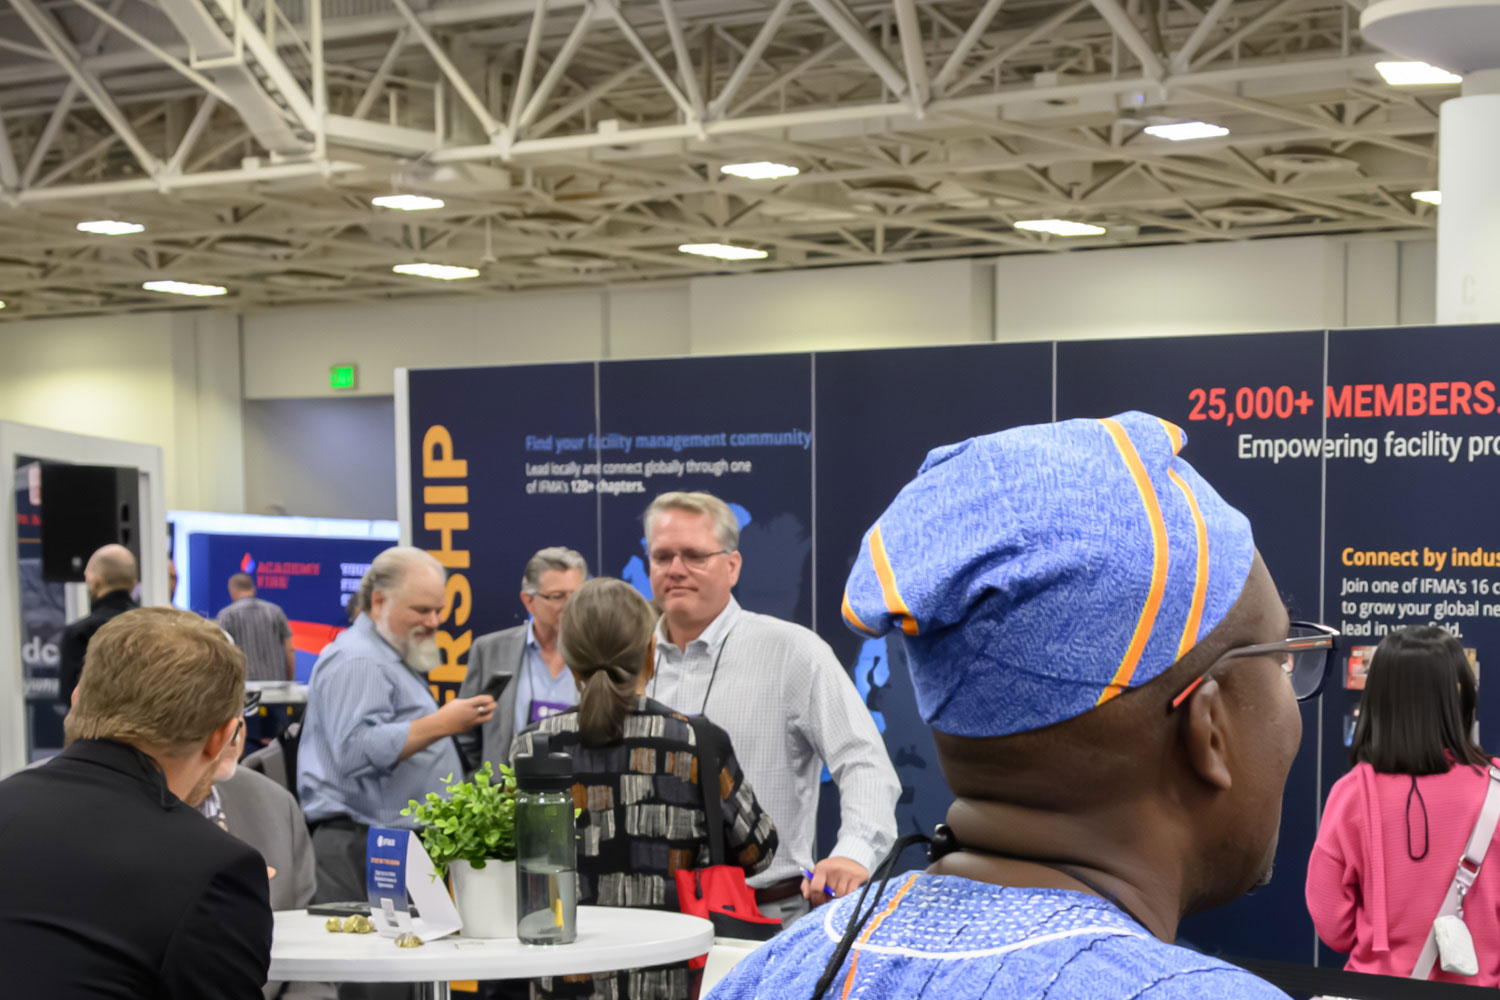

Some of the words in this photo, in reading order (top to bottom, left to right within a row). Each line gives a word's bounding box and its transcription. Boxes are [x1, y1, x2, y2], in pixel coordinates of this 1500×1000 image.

[1188, 386, 1314, 427] 25,000+
[525, 434, 553, 451] Find
[556, 437, 585, 455] your
[587, 433, 632, 453] facility
[635, 432, 726, 452] management
[729, 427, 812, 450] community
[1238, 433, 1377, 464] Empowering
[1384, 430, 1462, 462] facility
[525, 462, 550, 476] Lead
[602, 462, 643, 475] connect
[644, 459, 684, 478] globally
[686, 458, 729, 477] through
[730, 460, 752, 473] one
[571, 479, 595, 494] 120+
[1341, 547, 1419, 567] Connect
[1423, 547, 1447, 572] by
[1340, 577, 1368, 596] Join
[1371, 581, 1399, 594] one
[1402, 577, 1418, 593] of
[1420, 578, 1467, 594] IFMA's
[1471, 579, 1489, 594] 16
[1341, 601, 1357, 614] to
[1359, 602, 1395, 619] grow
[1398, 602, 1432, 619] your
[1434, 600, 1479, 620] global
[1341, 620, 1371, 636] lead
[1374, 621, 1387, 636] in
